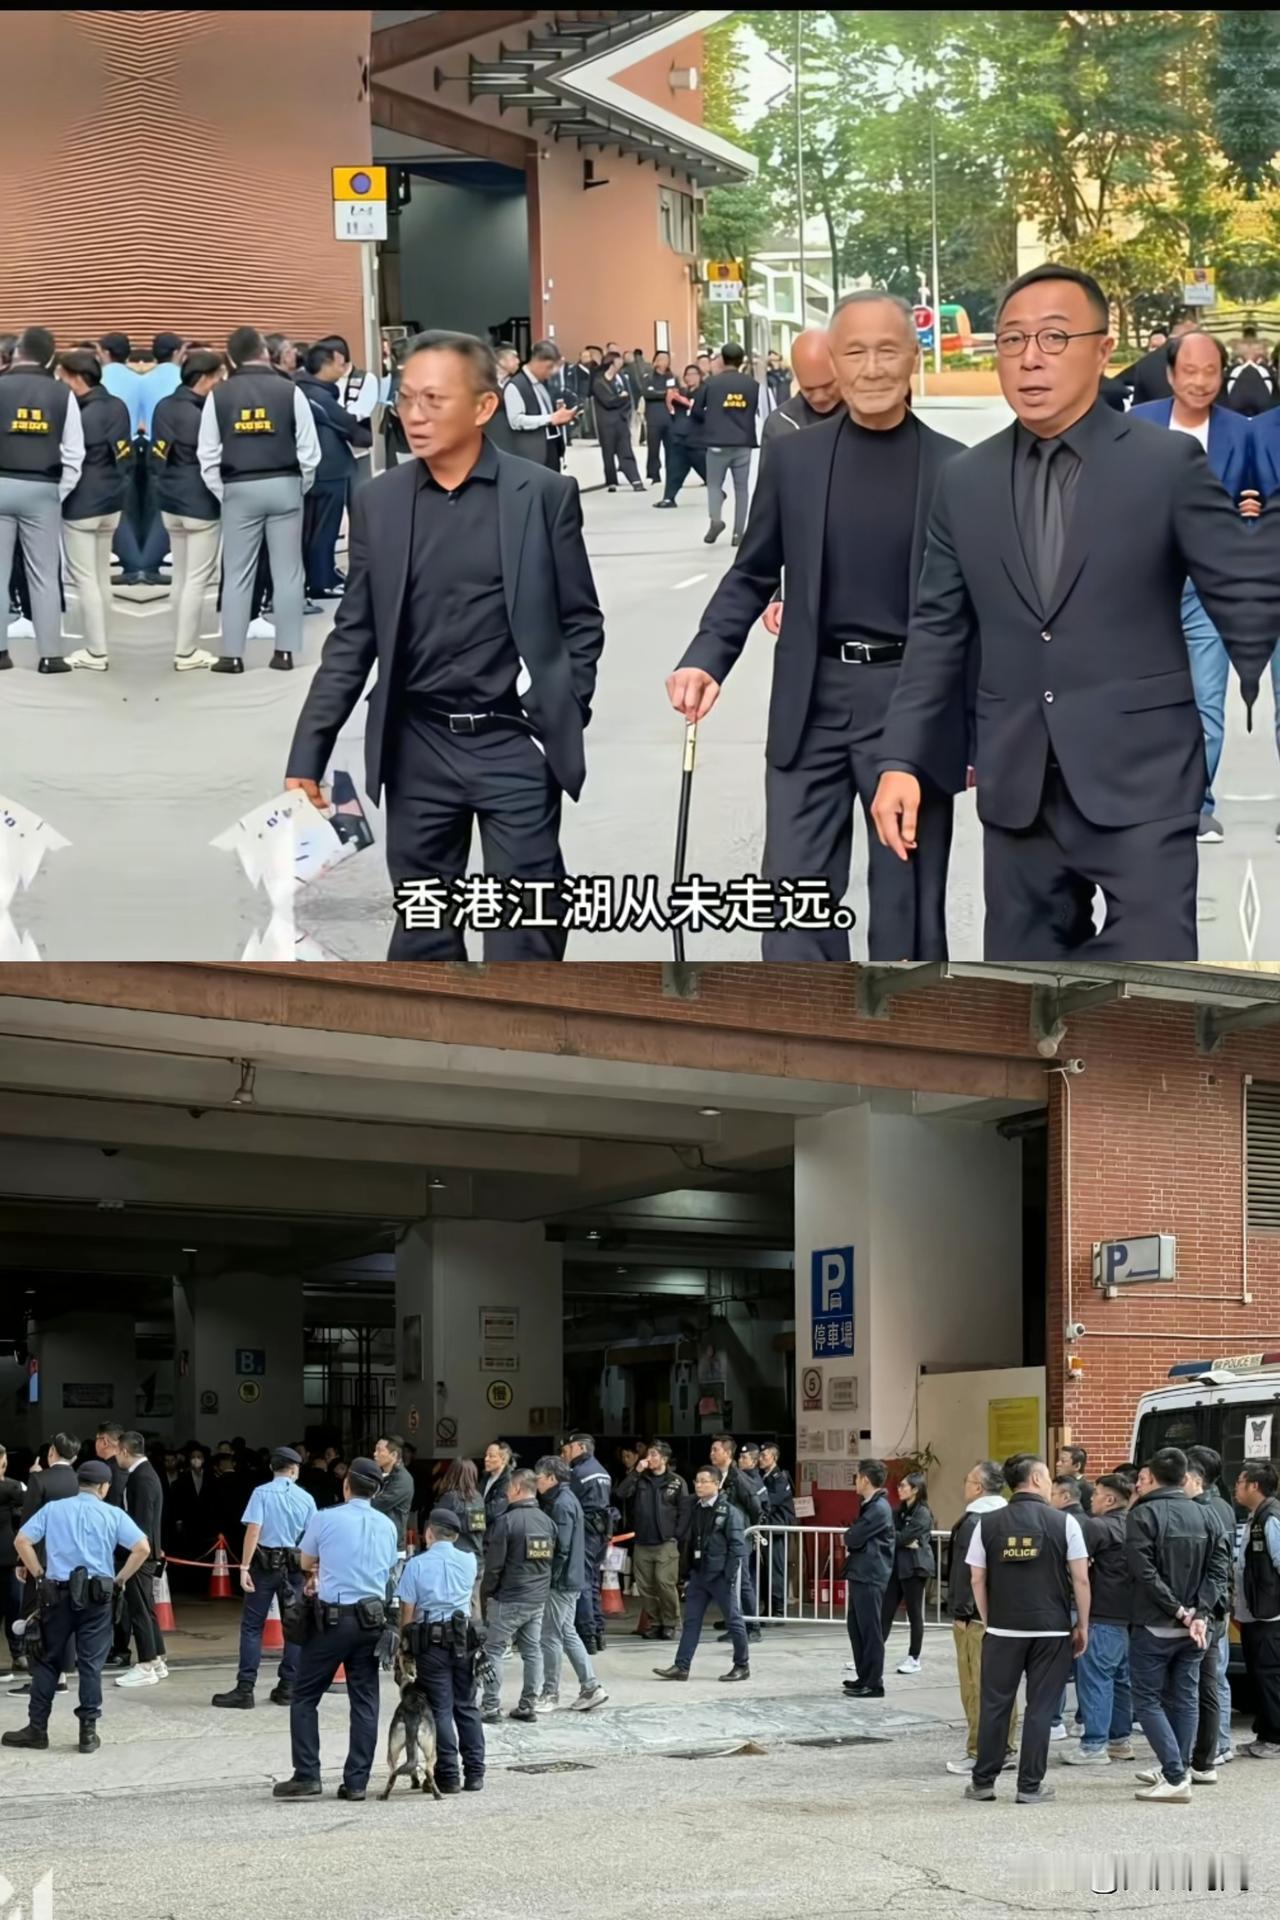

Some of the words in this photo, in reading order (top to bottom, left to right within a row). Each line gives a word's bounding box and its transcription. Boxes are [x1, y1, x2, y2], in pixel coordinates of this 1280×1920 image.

[1107, 1245, 1128, 1283] P
[822, 1254, 846, 1312] P
[814, 1321, 853, 1351] 停車場
[808, 1378, 816, 1392] 5
[1003, 1548, 1038, 1558] POLICE
